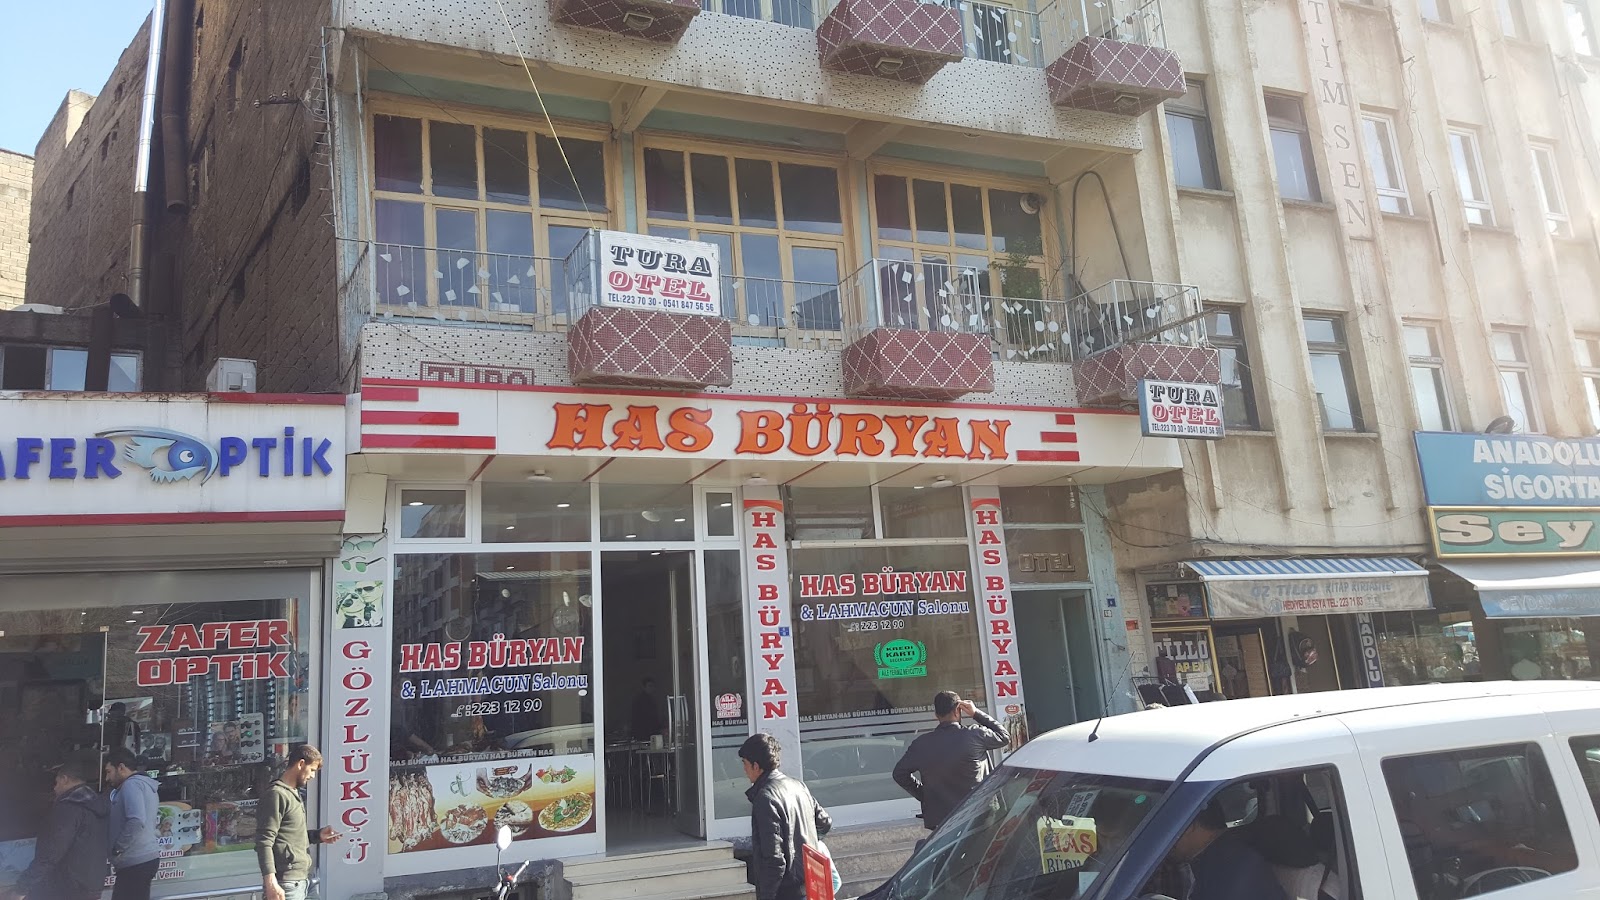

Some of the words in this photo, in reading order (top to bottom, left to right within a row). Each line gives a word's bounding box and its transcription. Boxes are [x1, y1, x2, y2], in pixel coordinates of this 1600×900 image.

[610, 245, 712, 278] TURA
[608, 270, 711, 302] OTEL
[637, 296, 646, 305] 70
[648, 297, 657, 306] 30
[663, 298, 679, 308] 0541
[681, 301, 693, 309] 847
[696, 302, 704, 311] 56
[1150, 385, 1218, 407] TURA
[545, 401, 714, 452] HAS
[734, 402, 1012, 460] BÜRYAN
[1152, 404, 1221, 426] OTEL
[1473, 440, 1600, 466] ANADOLU
[1484, 467, 1600, 500] SİGORTA
[751, 511, 777, 571] HAS
[975, 510, 1001, 565] HAS
[1436, 514, 1594, 550] Sey
[1019, 553, 1075, 572] OTEL
[800, 574, 856, 597] HAS
[862, 566, 967, 595] BÜRYAN
[801, 604, 814, 621] &
[817, 601, 913, 620] LAHMACUN
[917, 599, 970, 616] Salonu
[880, 620, 891, 630] 12
[892, 619, 904, 629] 90
[136, 619, 290, 654] ZAFER
[399, 642, 461, 672] HAS
[468, 633, 584, 669] BÜRYAN
[757, 584, 788, 720] BÜRYAN
[985, 575, 1019, 698] BÜRYAN
[1358, 612, 1381, 682] NADOLU
[401, 681, 415, 699] &
[420, 675, 531, 698] LAHMACUN
[532, 672, 588, 692] Salonu
[504, 700, 520, 713] 12
[523, 698, 542, 712] 90
[340, 640, 373, 863] GÖZLÜKÇÜ
[159, 869, 184, 879] Verilir
